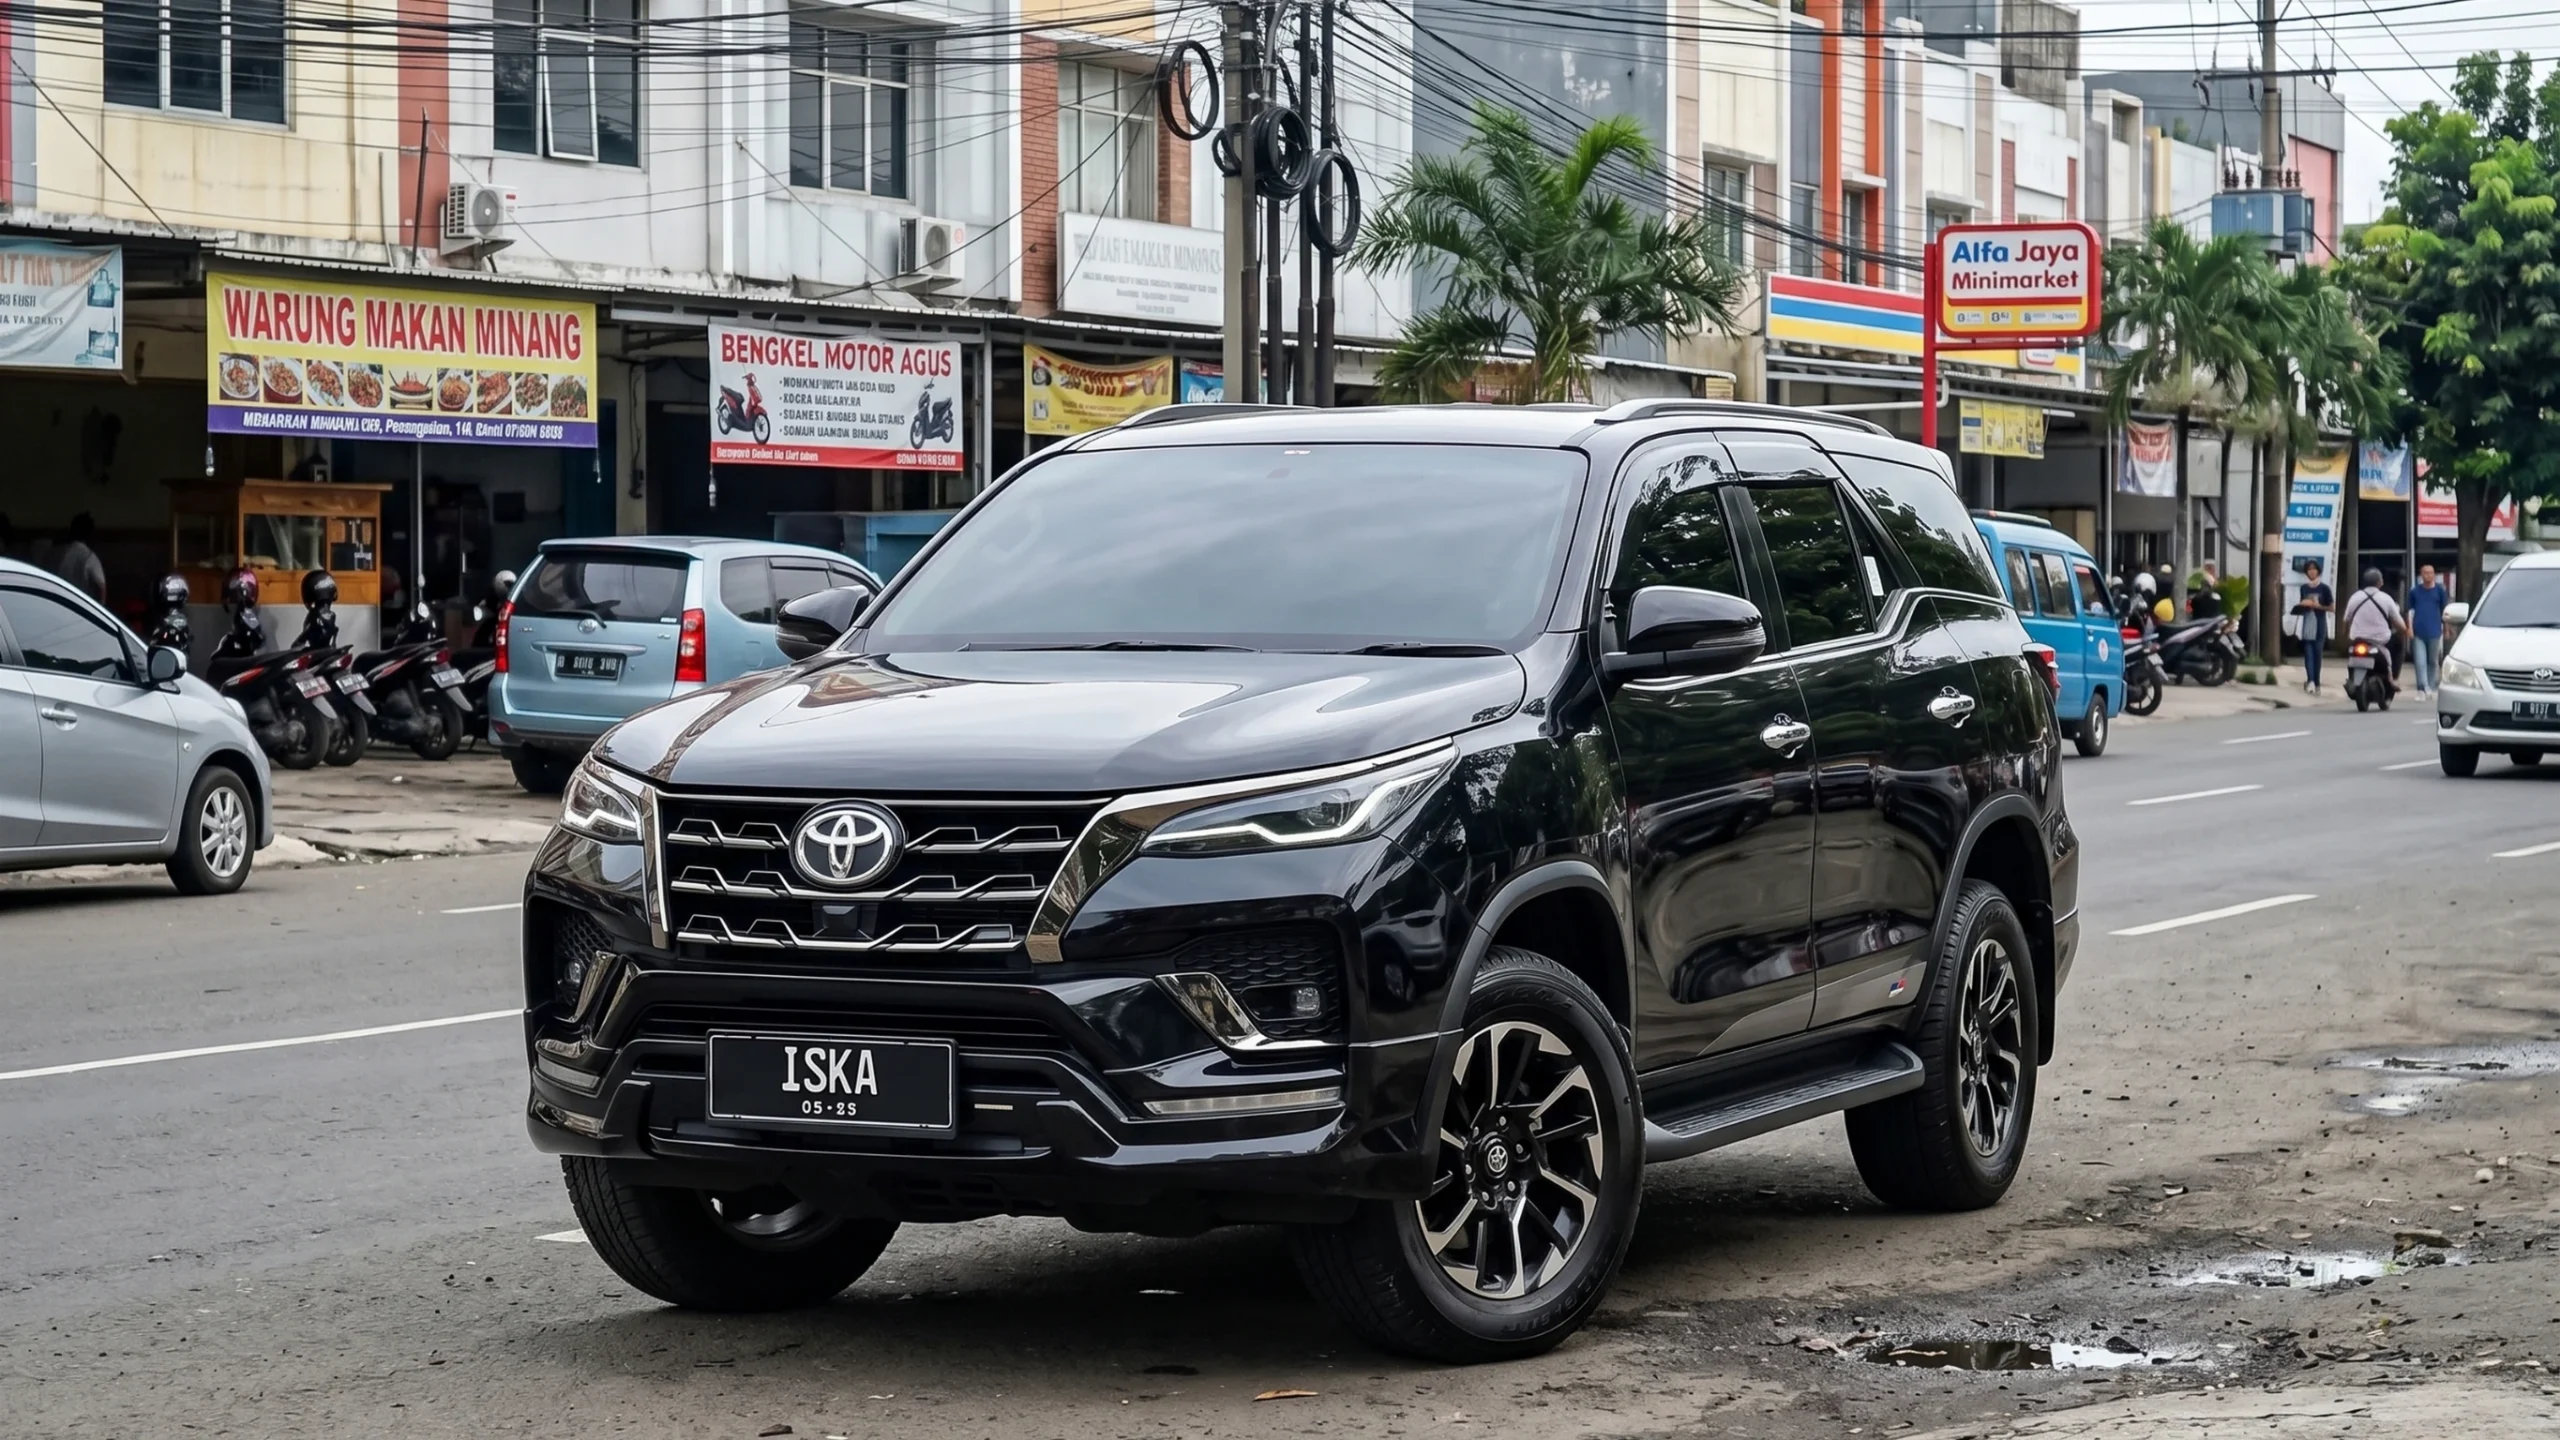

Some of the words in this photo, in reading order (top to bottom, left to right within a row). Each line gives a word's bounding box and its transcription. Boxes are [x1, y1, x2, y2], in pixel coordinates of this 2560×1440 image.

[1952, 241, 2009, 263] Alfa
[2015, 240, 2079, 267] Jaya
[1952, 269, 2079, 290] Minimarket
[224, 287, 356, 346] WARUNG
[365, 299, 466, 354] MAKAN
[475, 308, 581, 361] MINANG
[721, 333, 819, 369] BENGKEL
[825, 342, 894, 374] MOTOR
[900, 348, 952, 377] AGUS
[782, 1046, 878, 1095] ISKA
